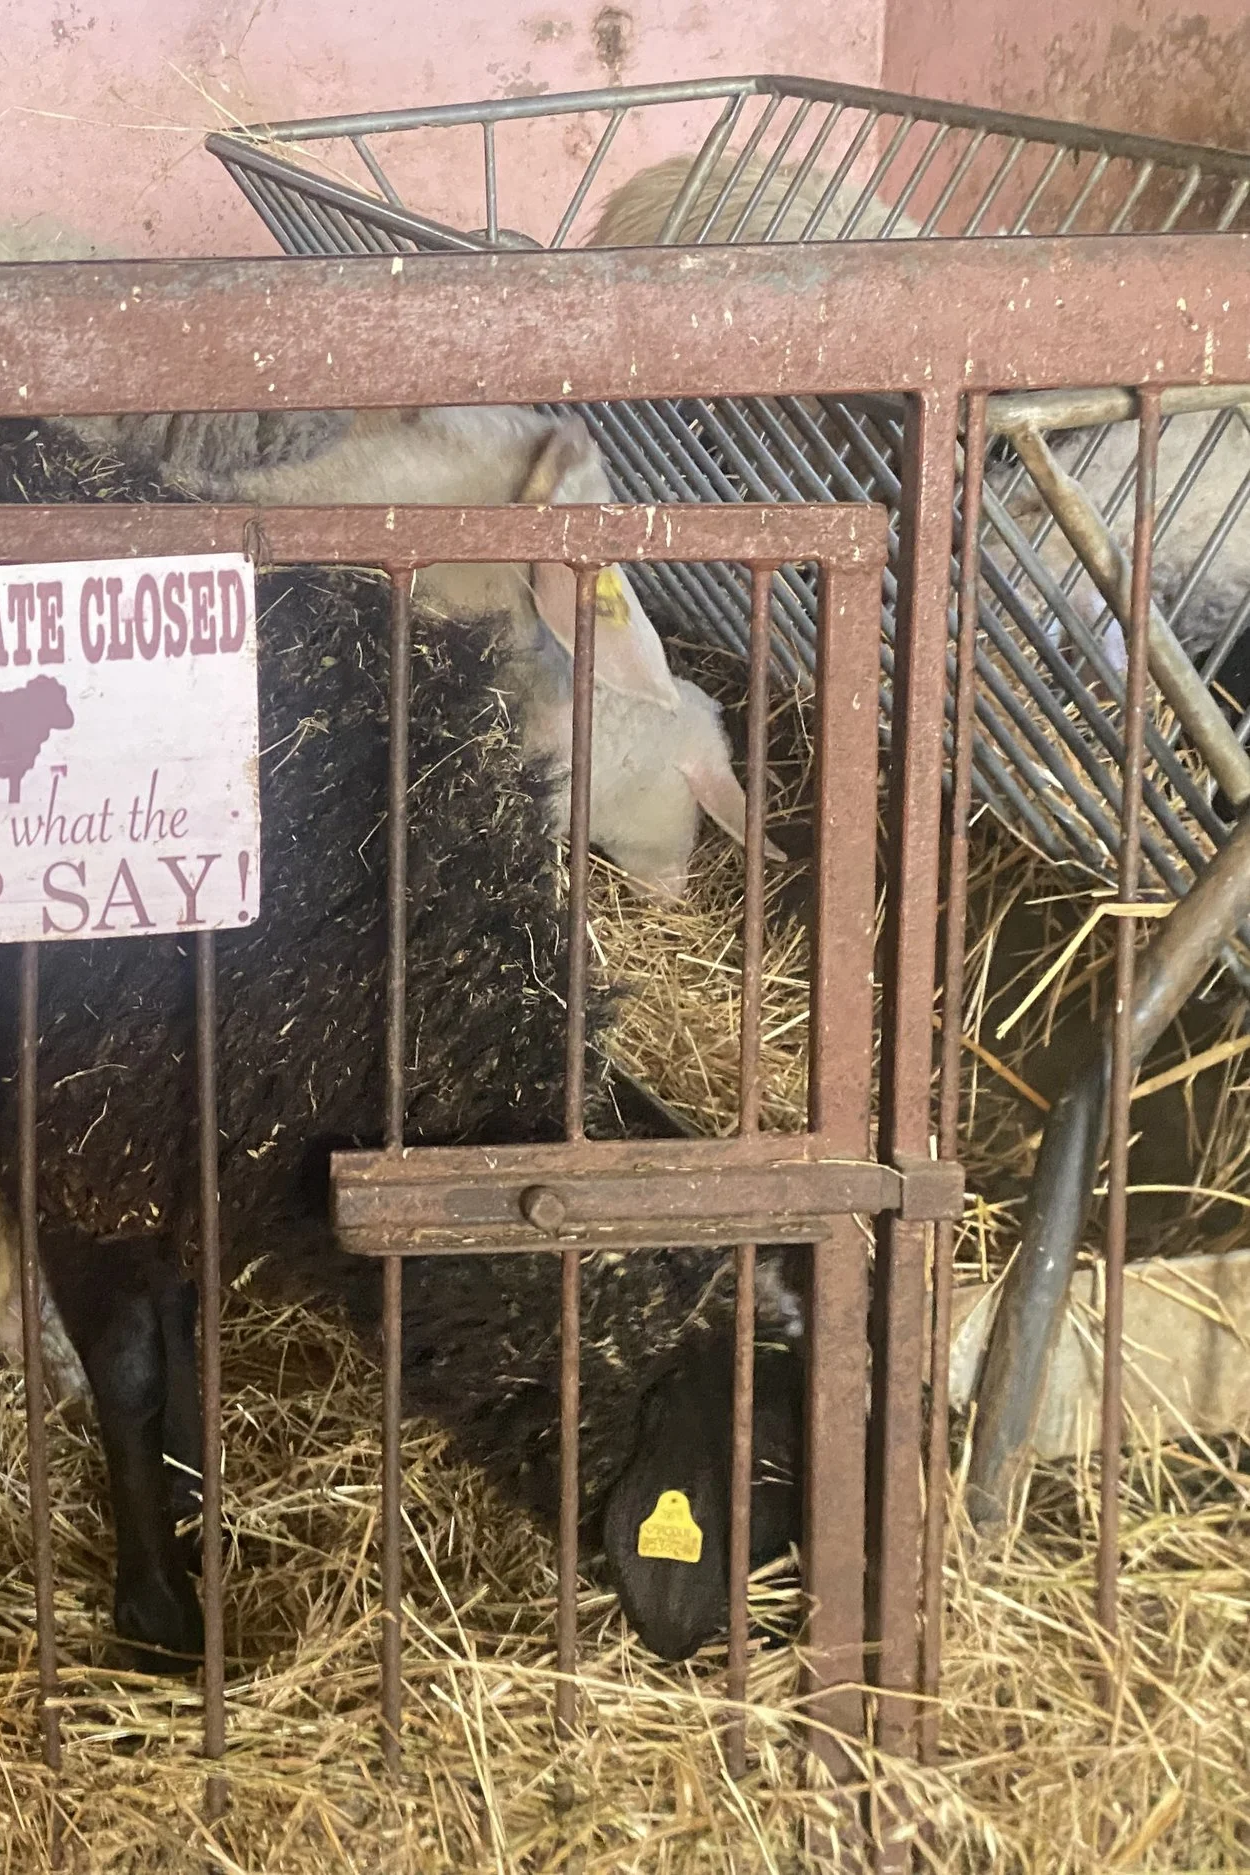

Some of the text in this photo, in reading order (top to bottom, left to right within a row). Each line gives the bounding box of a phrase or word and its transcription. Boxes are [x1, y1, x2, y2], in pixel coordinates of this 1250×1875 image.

[79, 568, 247, 663] CLOSED
[12, 771, 114, 848] what
[128, 767, 190, 844] the
